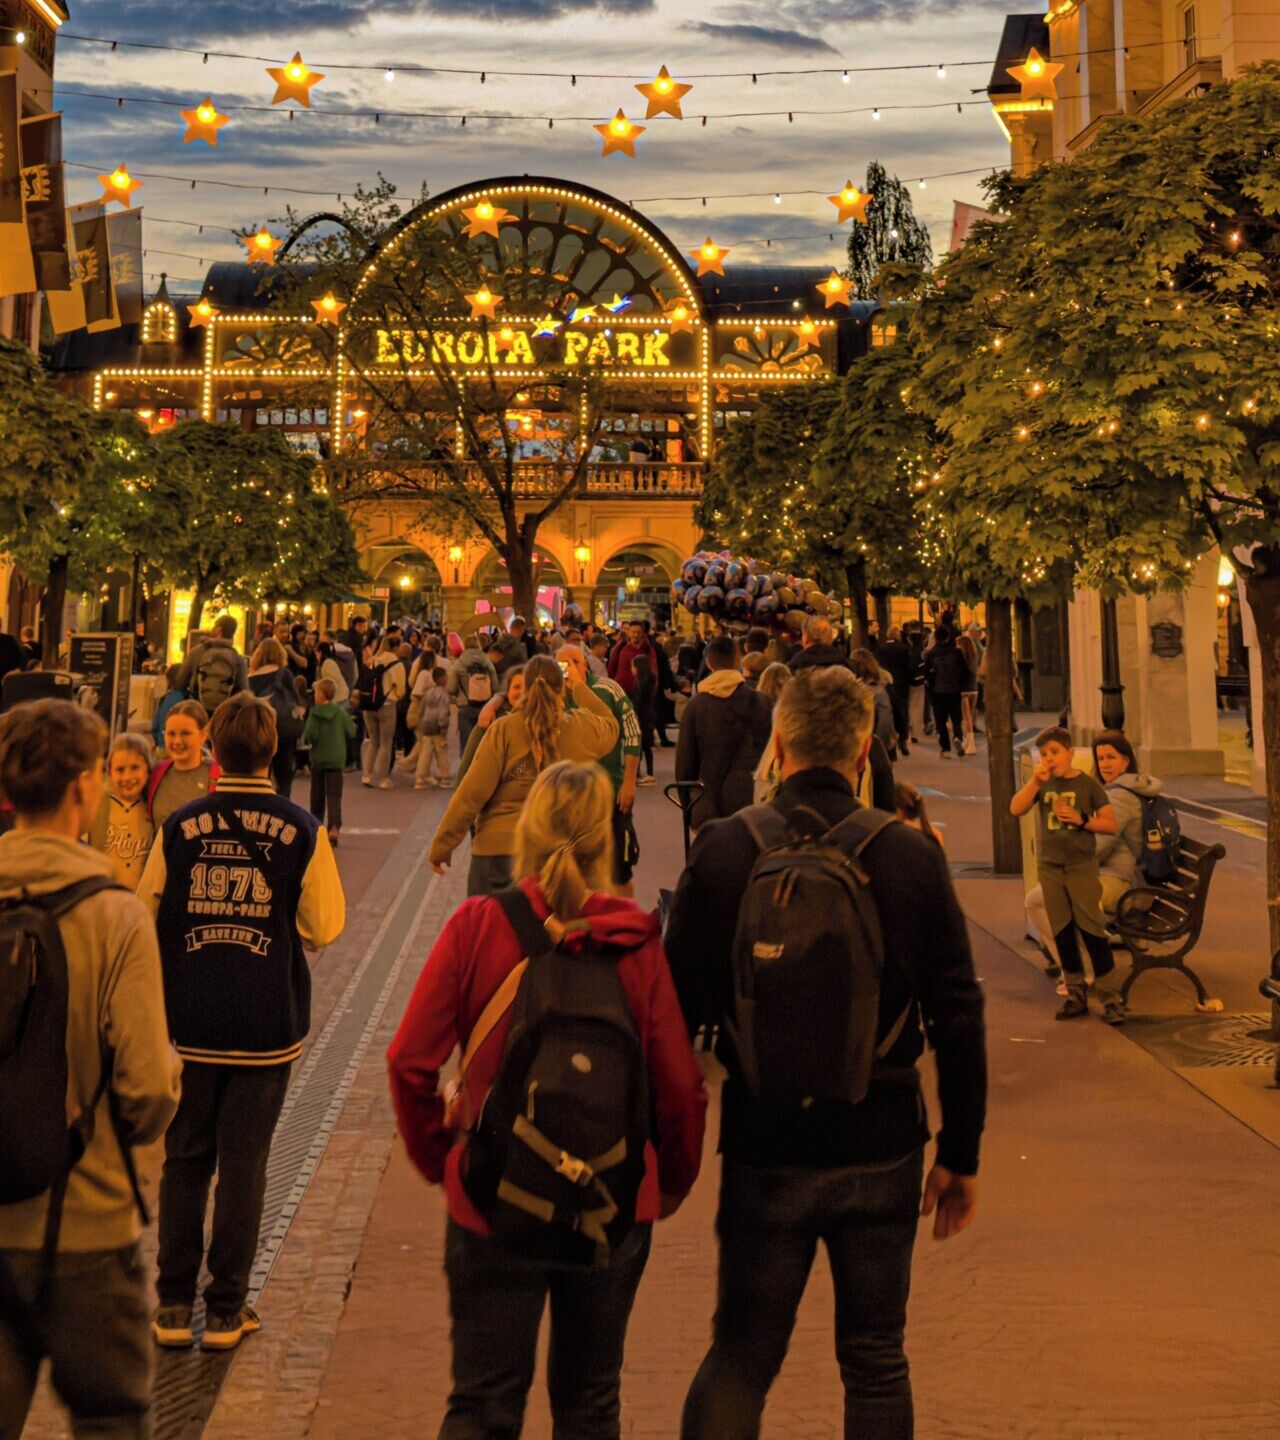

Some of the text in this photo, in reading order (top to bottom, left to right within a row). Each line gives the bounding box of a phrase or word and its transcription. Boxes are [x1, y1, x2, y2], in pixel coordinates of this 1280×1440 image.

[563, 331, 670, 366] PARK
[180, 809, 298, 846] NO LMITS
[189, 862, 273, 903] 1975
[187, 900, 271, 918] EUROPA-PARK
[202, 928, 254, 943] HAVE FUN
